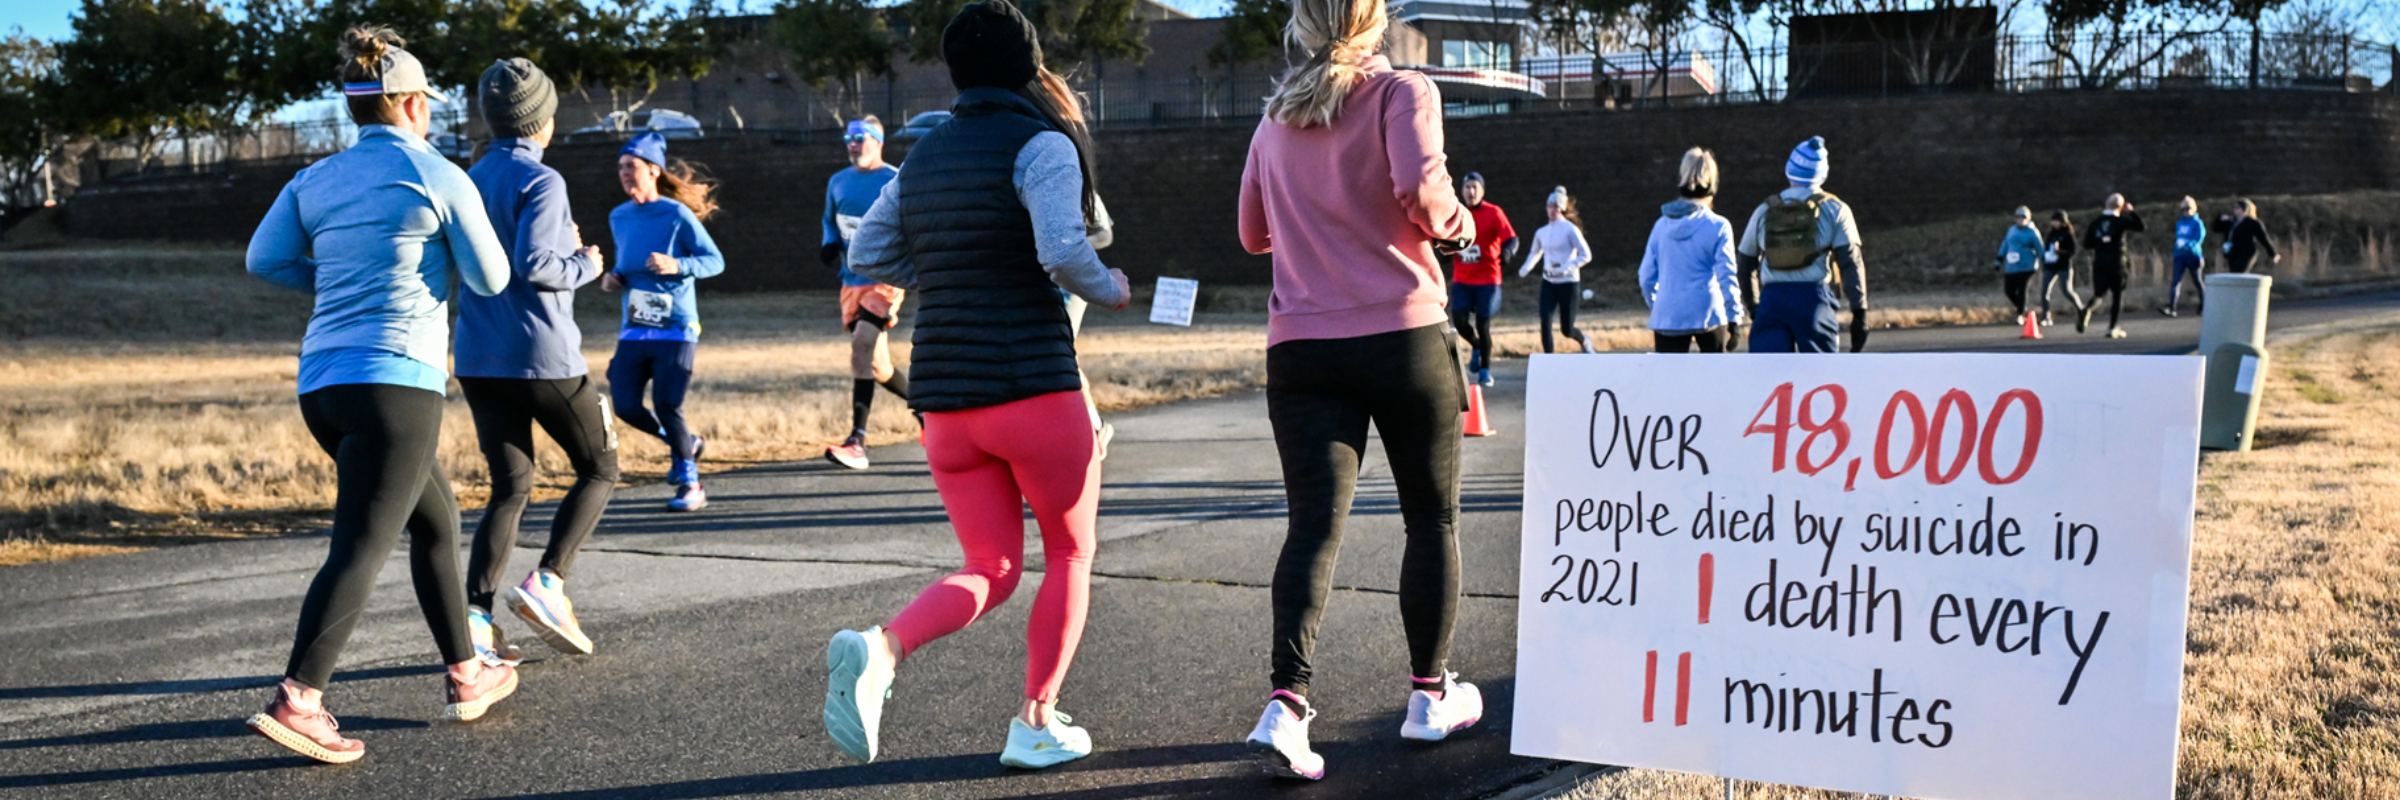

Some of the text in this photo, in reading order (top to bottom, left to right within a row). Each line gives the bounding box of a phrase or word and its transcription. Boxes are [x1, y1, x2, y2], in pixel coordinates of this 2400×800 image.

[1744, 382, 2044, 491] 48,000
[1555, 491, 2100, 577] people died by suicide in
[1541, 554, 1639, 607] 2021
[1744, 558, 1903, 643] death
[1929, 593, 2111, 706] every
[1642, 650, 1954, 749] 11 minutes
